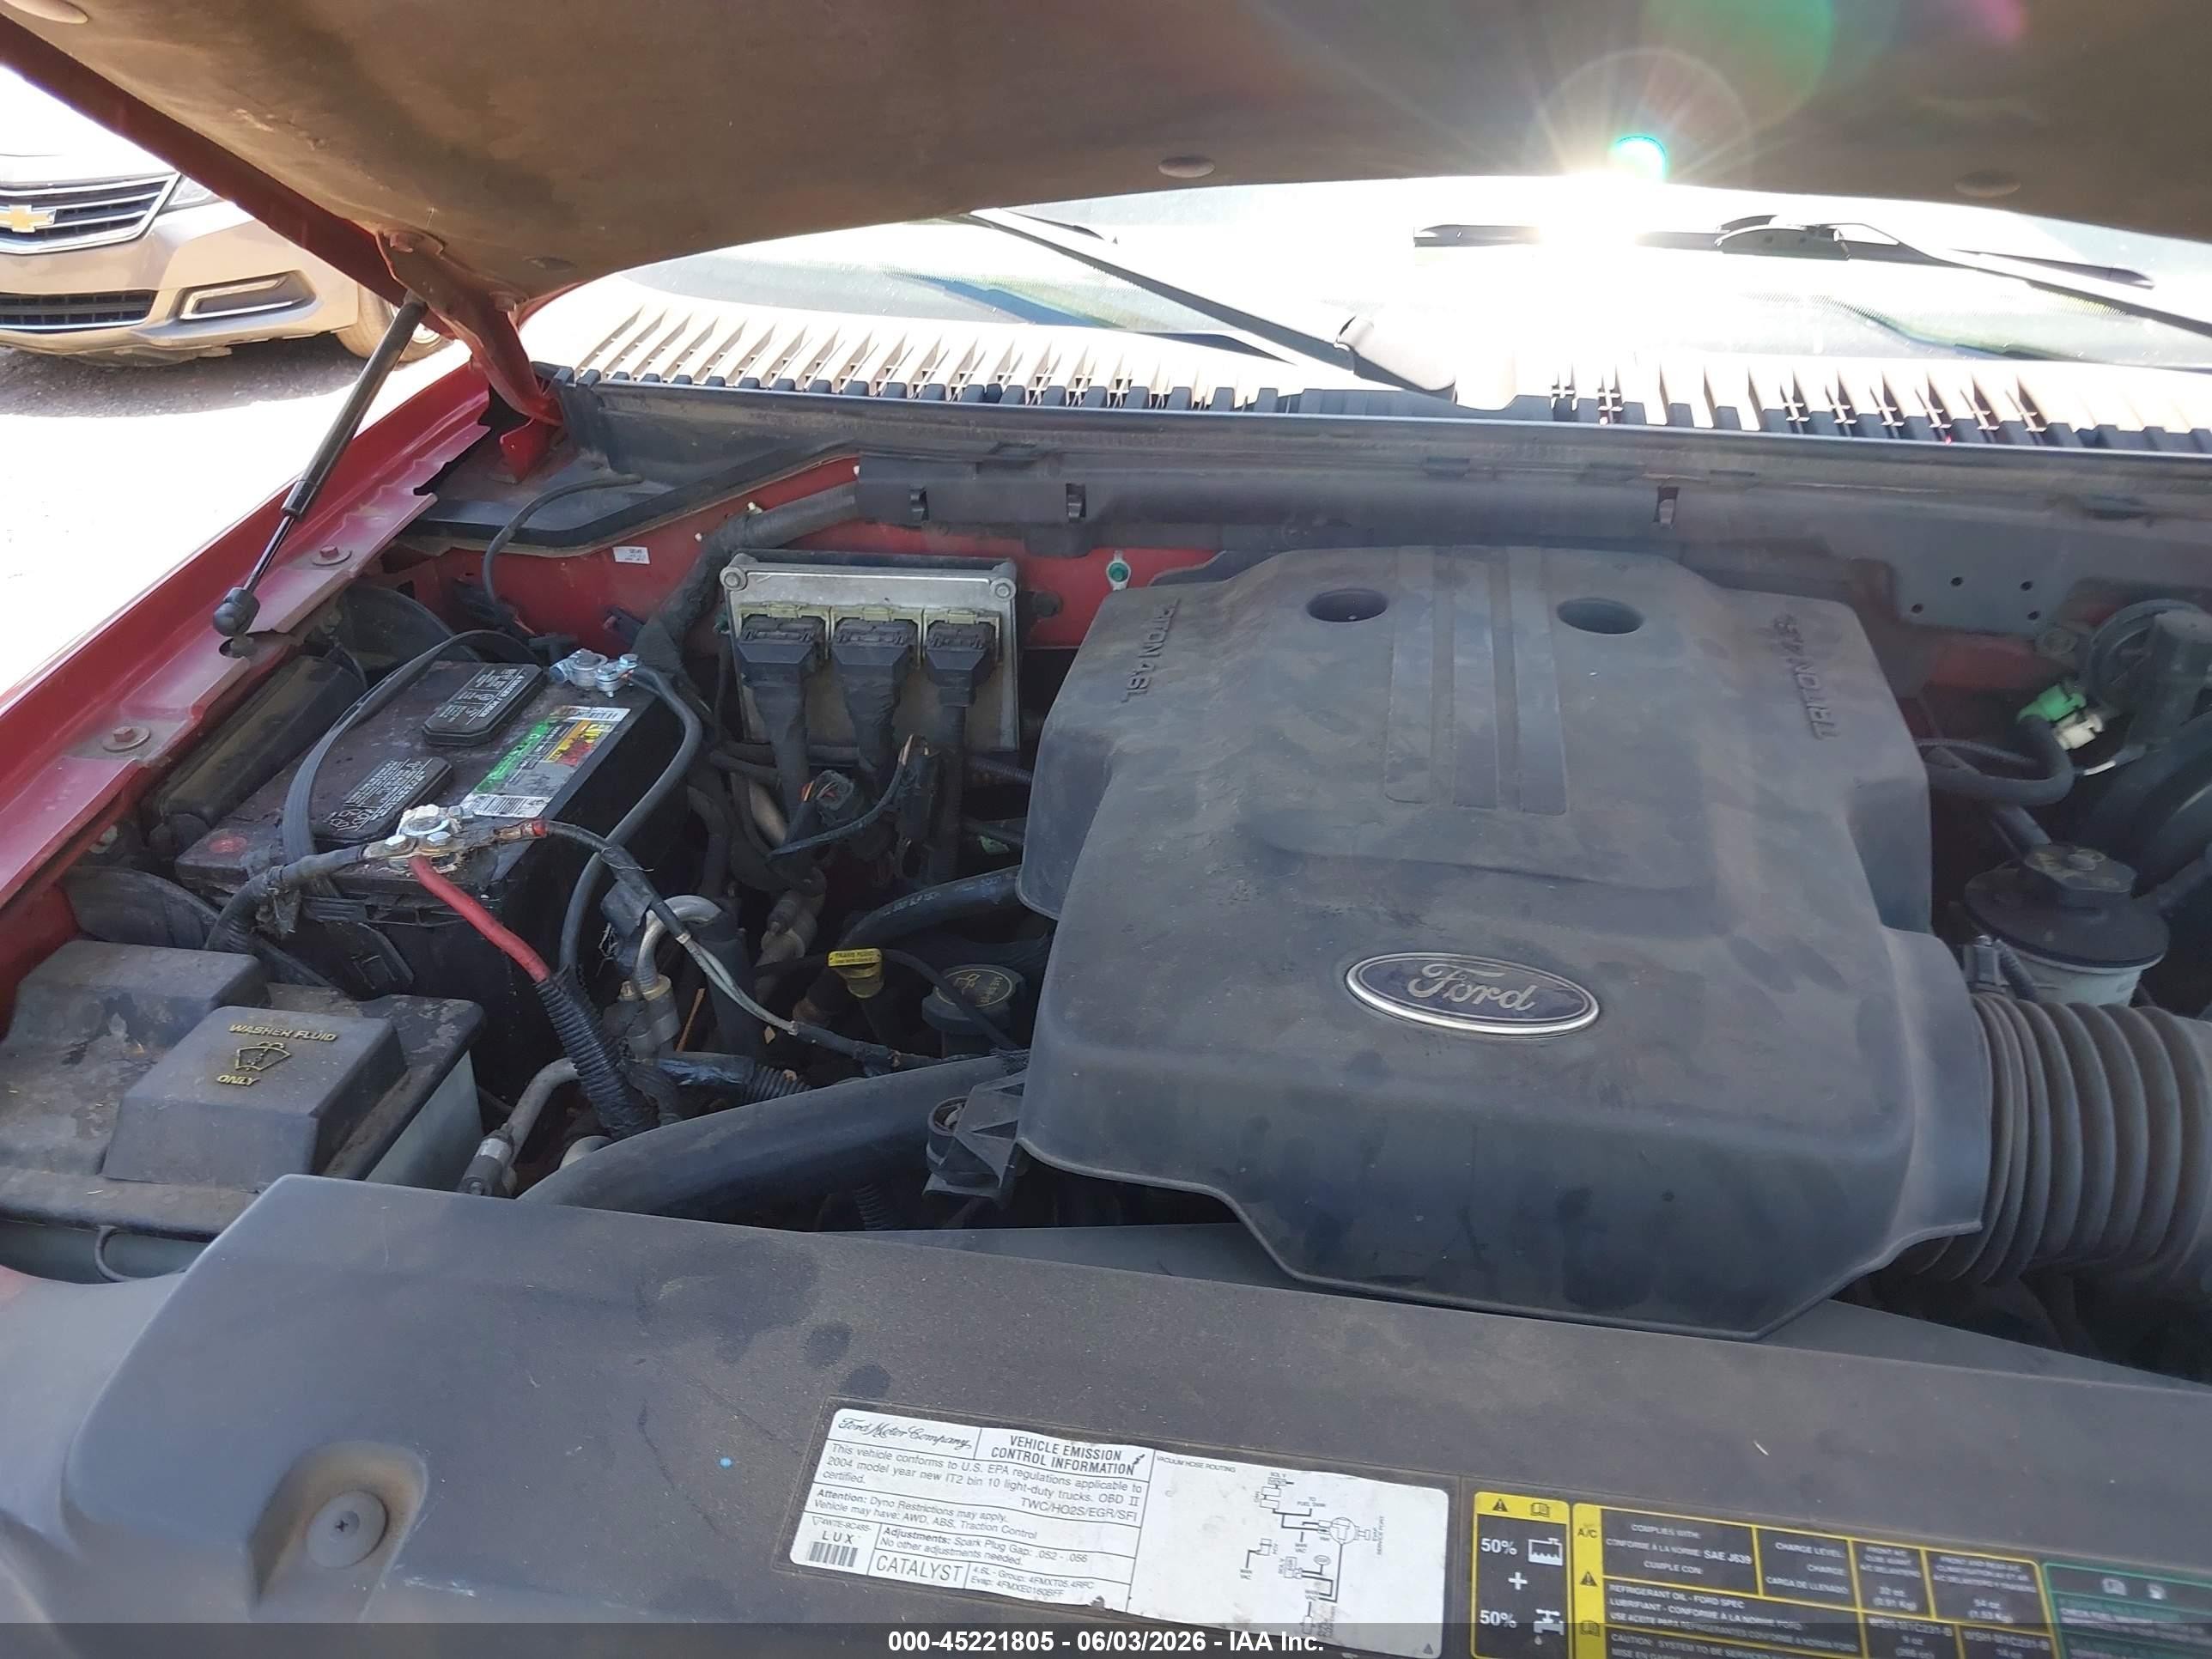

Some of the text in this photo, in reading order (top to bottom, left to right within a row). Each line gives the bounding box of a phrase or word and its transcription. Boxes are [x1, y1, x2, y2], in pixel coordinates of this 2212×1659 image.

[1407, 963, 1538, 1011] Ford
[228, 1024, 338, 1042] WASHER FLUID
[216, 1074, 260, 1086] ONLY
[838, 1418, 972, 1450] Ford Motor Company
[991, 1447, 1134, 1475] CONTROL INFORMATION
[1010, 1435, 1121, 1462] VEHICLE EMISSION
[823, 1470, 866, 1484] certified.
[827, 1455, 853, 1468] 2004
[857, 1461, 889, 1473] model
[892, 1466, 917, 1477] year
[920, 1471, 941, 1480] new
[966, 1476, 983, 1486] bin
[988, 1478, 1000, 1487] 10
[1004, 1480, 1054, 1498] light-duty
[1058, 1490, 1092, 1502] trucks.
[1098, 1493, 1124, 1504] OBD
[1129, 1497, 1140, 1506] II
[832, 1443, 1142, 1493] This vehicle conforms to U.S. EPA regulations applicable to
[815, 1498, 848, 1512] Vehicle
[851, 1506, 872, 1516] may
[873, 1509, 900, 1520] have:
[961, 1520, 998, 1532] Traction
[1001, 1524, 1037, 1539] Control
[817, 1488, 1008, 1522] Attention: Dyno Restrictions may apply.
[1021, 1497, 1139, 1522] TWC/HO2S/EGR/SFI
[884, 1528, 951, 1544] Adjustments:
[955, 1537, 981, 1547] Spark
[985, 1539, 1006, 1552] Plug
[1009, 1546, 1033, 1557] Gap:
[1480, 1537, 1517, 1555] 50%
[1577, 1528, 1598, 1538] A/C
[880, 1536, 1024, 1566] No other adjustments needed.
[1704, 1549, 1726, 1561] SAE
[876, 1554, 963, 1583] CATALYST
[998, 1570, 1026, 1583] Group:
[1480, 1609, 1517, 1628] 50%
